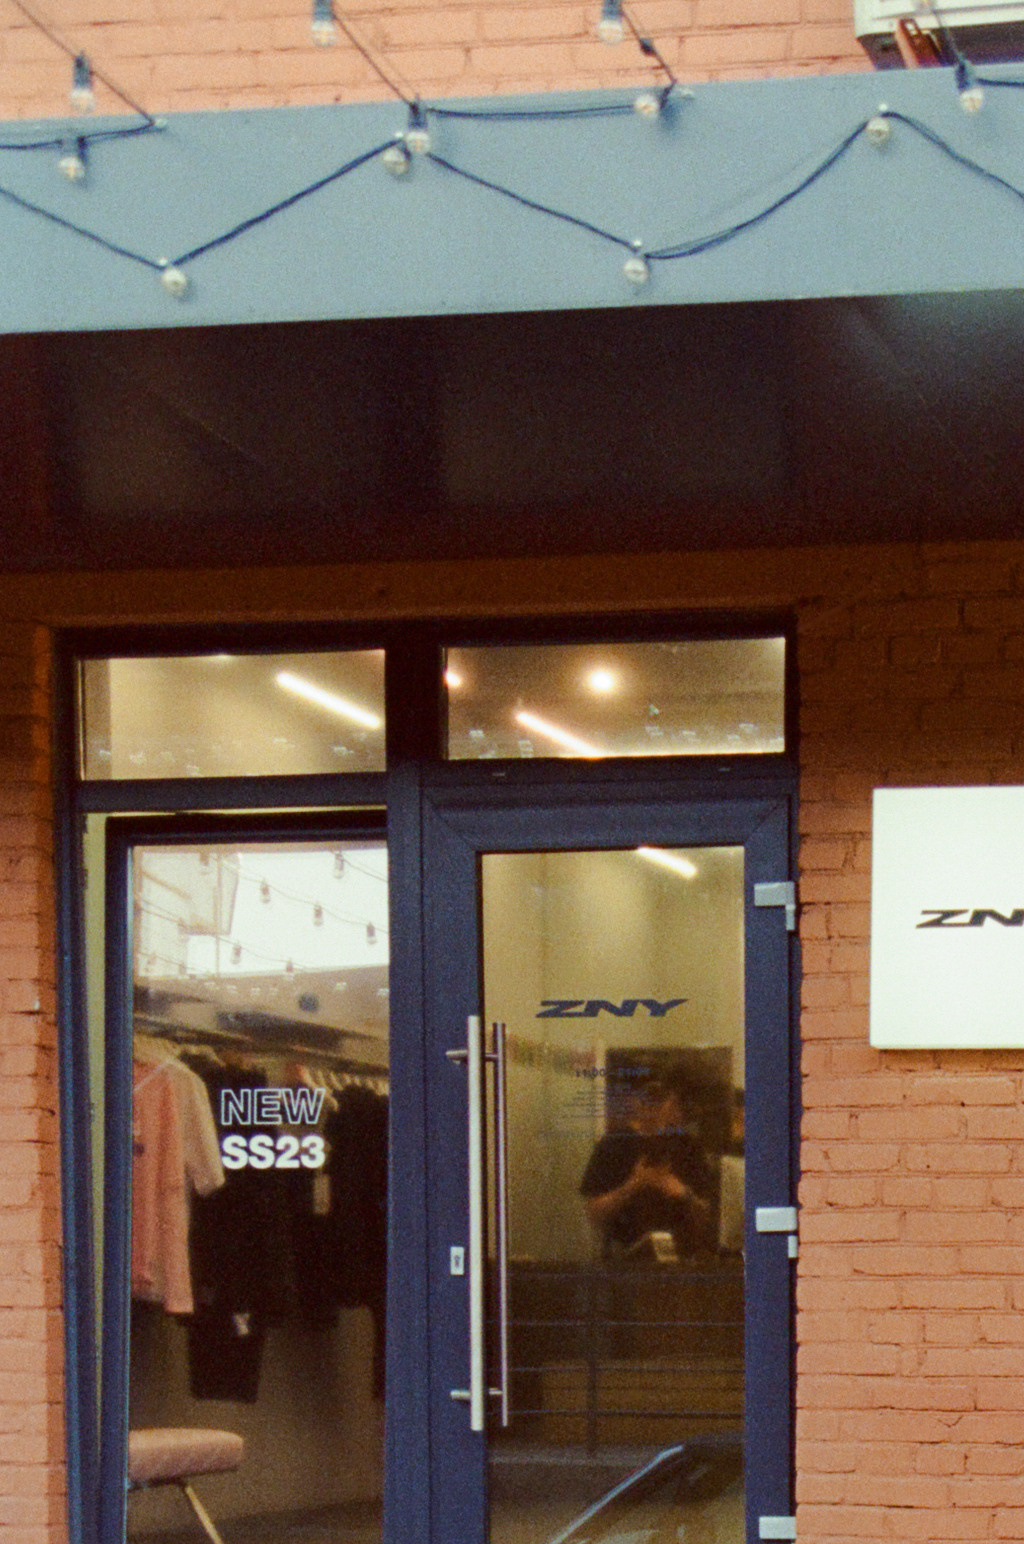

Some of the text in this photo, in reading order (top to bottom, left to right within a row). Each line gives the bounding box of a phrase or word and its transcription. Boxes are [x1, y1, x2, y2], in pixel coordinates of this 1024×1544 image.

[535, 998, 689, 1018] ZNY
[221, 1088, 326, 1125] NEW
[221, 1134, 326, 1169] SS23
